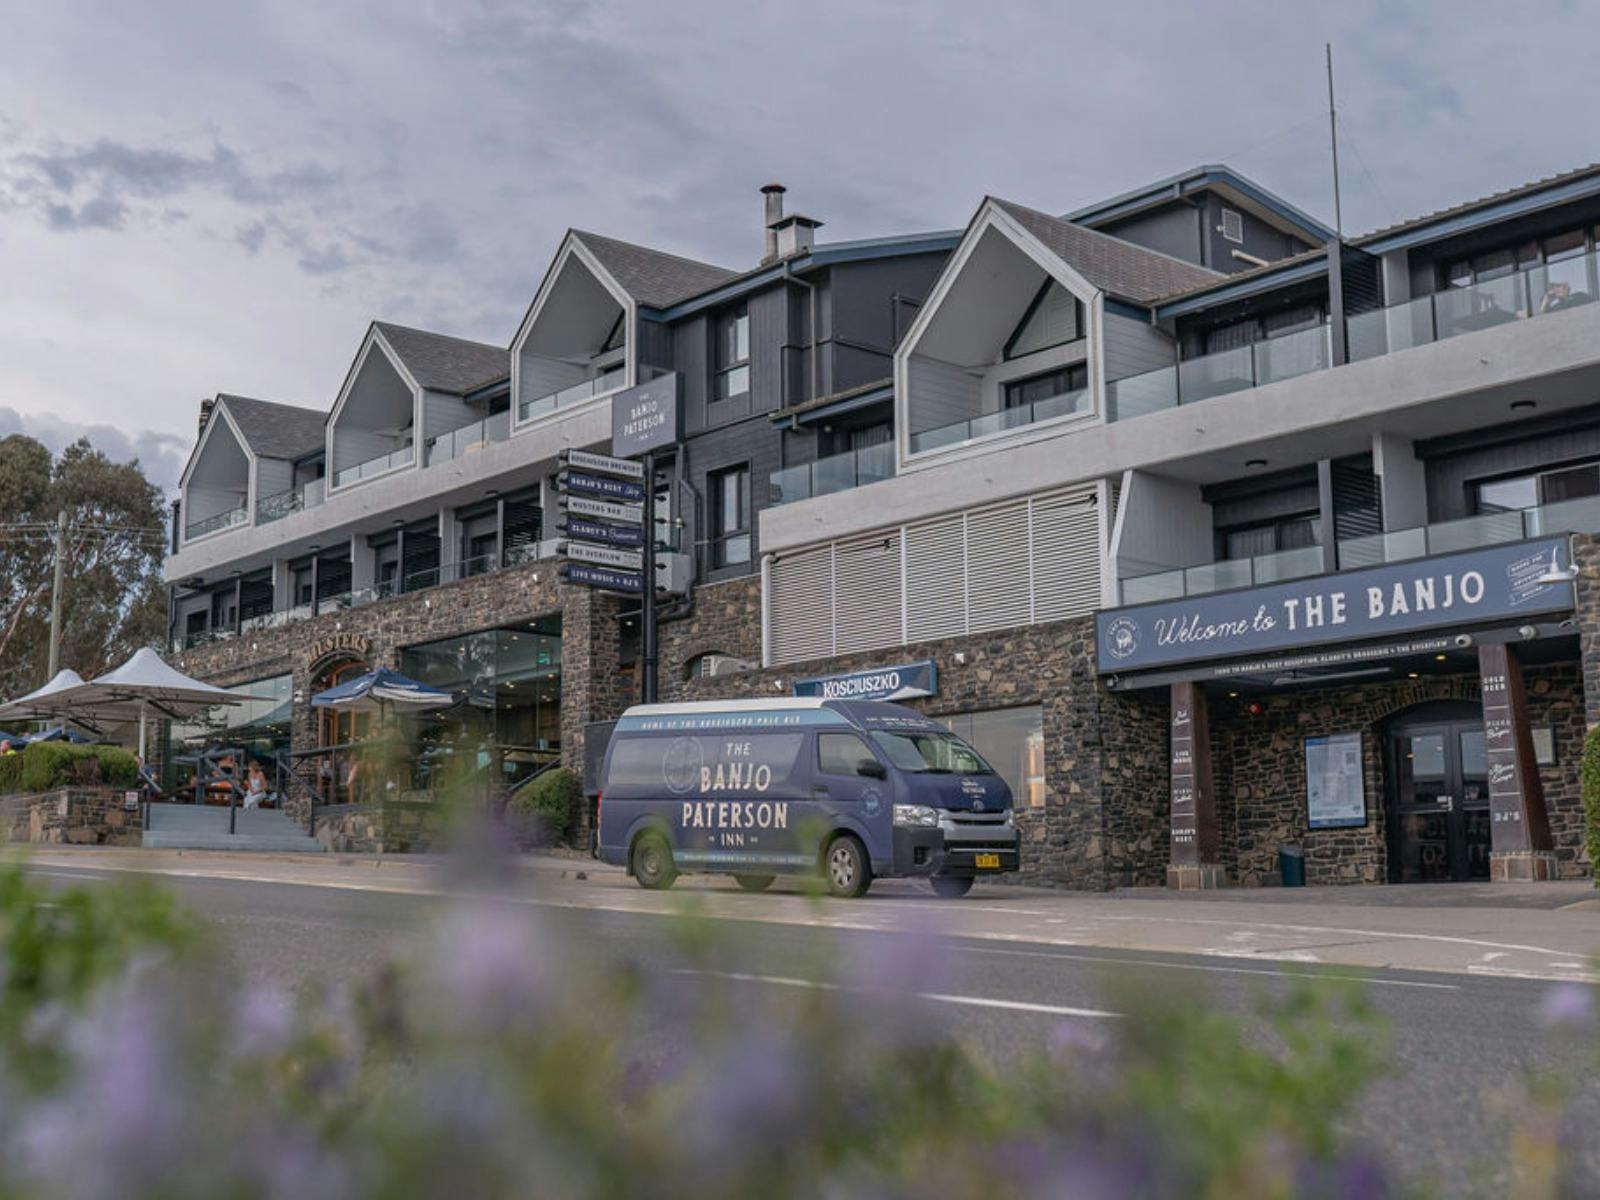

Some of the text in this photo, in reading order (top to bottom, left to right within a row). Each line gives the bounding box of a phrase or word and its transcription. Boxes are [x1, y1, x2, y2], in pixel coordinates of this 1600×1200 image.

[1154, 613, 1249, 646] Welcome
[1252, 604, 1277, 632] to
[1284, 592, 1346, 630] THE
[1367, 571, 1485, 619] BANJO
[824, 672, 899, 698] KOSCIUSZKO
[727, 742, 752, 756] THE
[701, 762, 771, 793] BANJO
[682, 802, 788, 828] PATERSON
[721, 833, 745, 846] INN
